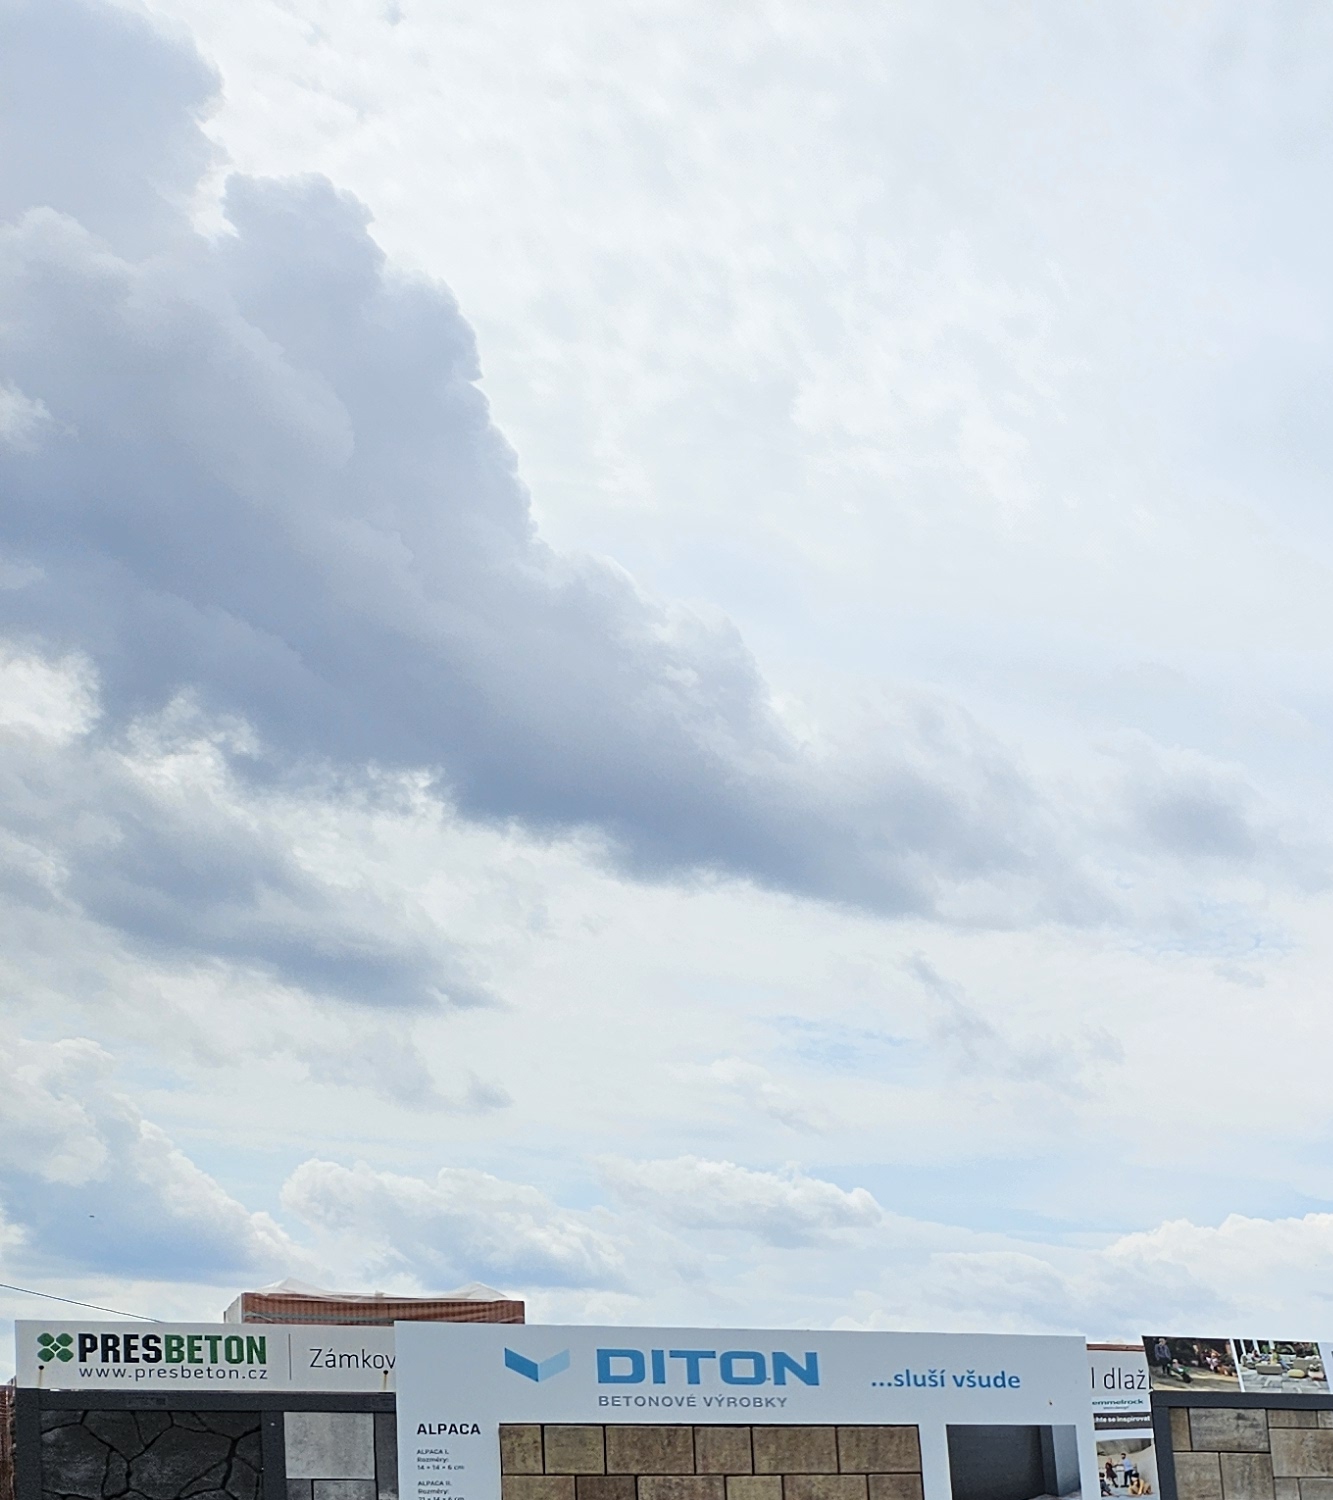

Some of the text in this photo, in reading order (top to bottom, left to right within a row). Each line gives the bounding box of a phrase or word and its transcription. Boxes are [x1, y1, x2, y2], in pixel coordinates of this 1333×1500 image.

[78, 1333, 267, 1365] PRESBETON
[309, 1348, 396, 1370] Zámkov
[596, 1349, 820, 1386] DITON
[79, 1366, 268, 1381] www.presbeton.cz
[952, 1370, 1020, 1389] všude
[598, 1393, 788, 1408] BETONOVÉ VÝROBKY
[417, 1423, 481, 1435] ALPACA
